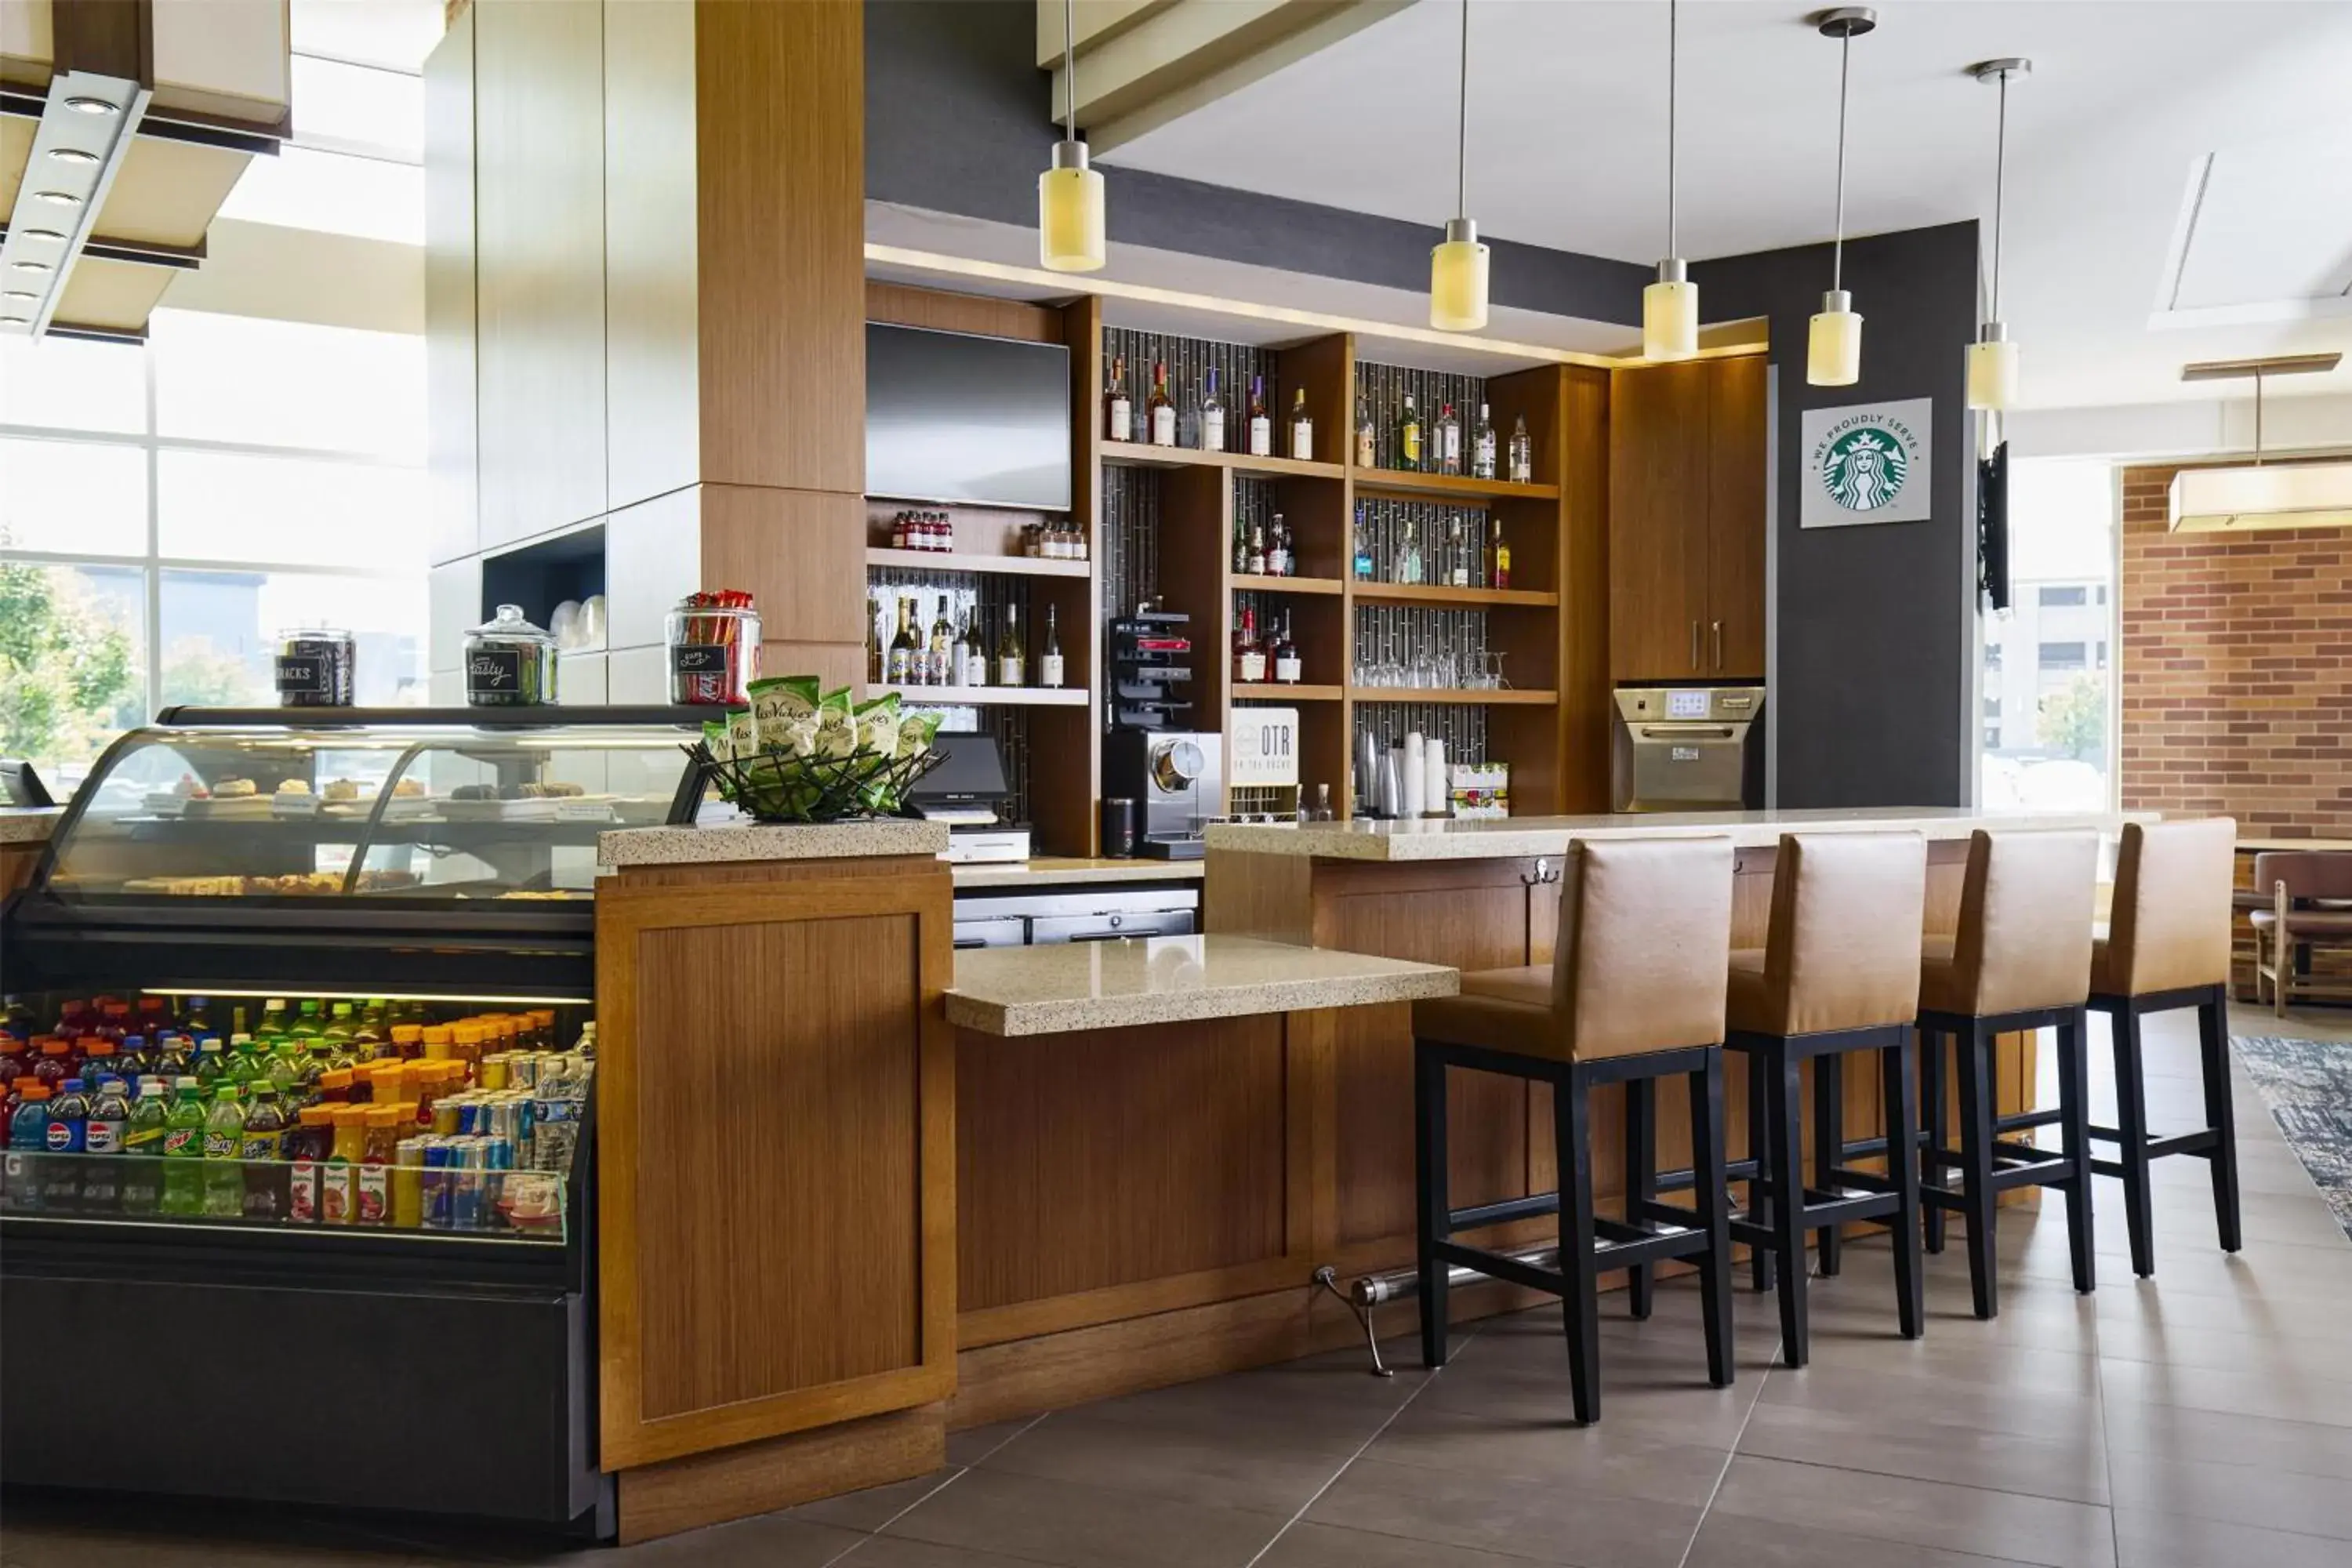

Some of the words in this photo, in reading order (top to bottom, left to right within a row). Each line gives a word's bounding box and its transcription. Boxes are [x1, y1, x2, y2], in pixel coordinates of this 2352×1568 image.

[1813, 441, 1828, 459] WE
[1827, 414, 1883, 440] PROUDLY
[1887, 418, 1918, 450] SERVE
[1261, 724, 1290, 757] OTR
